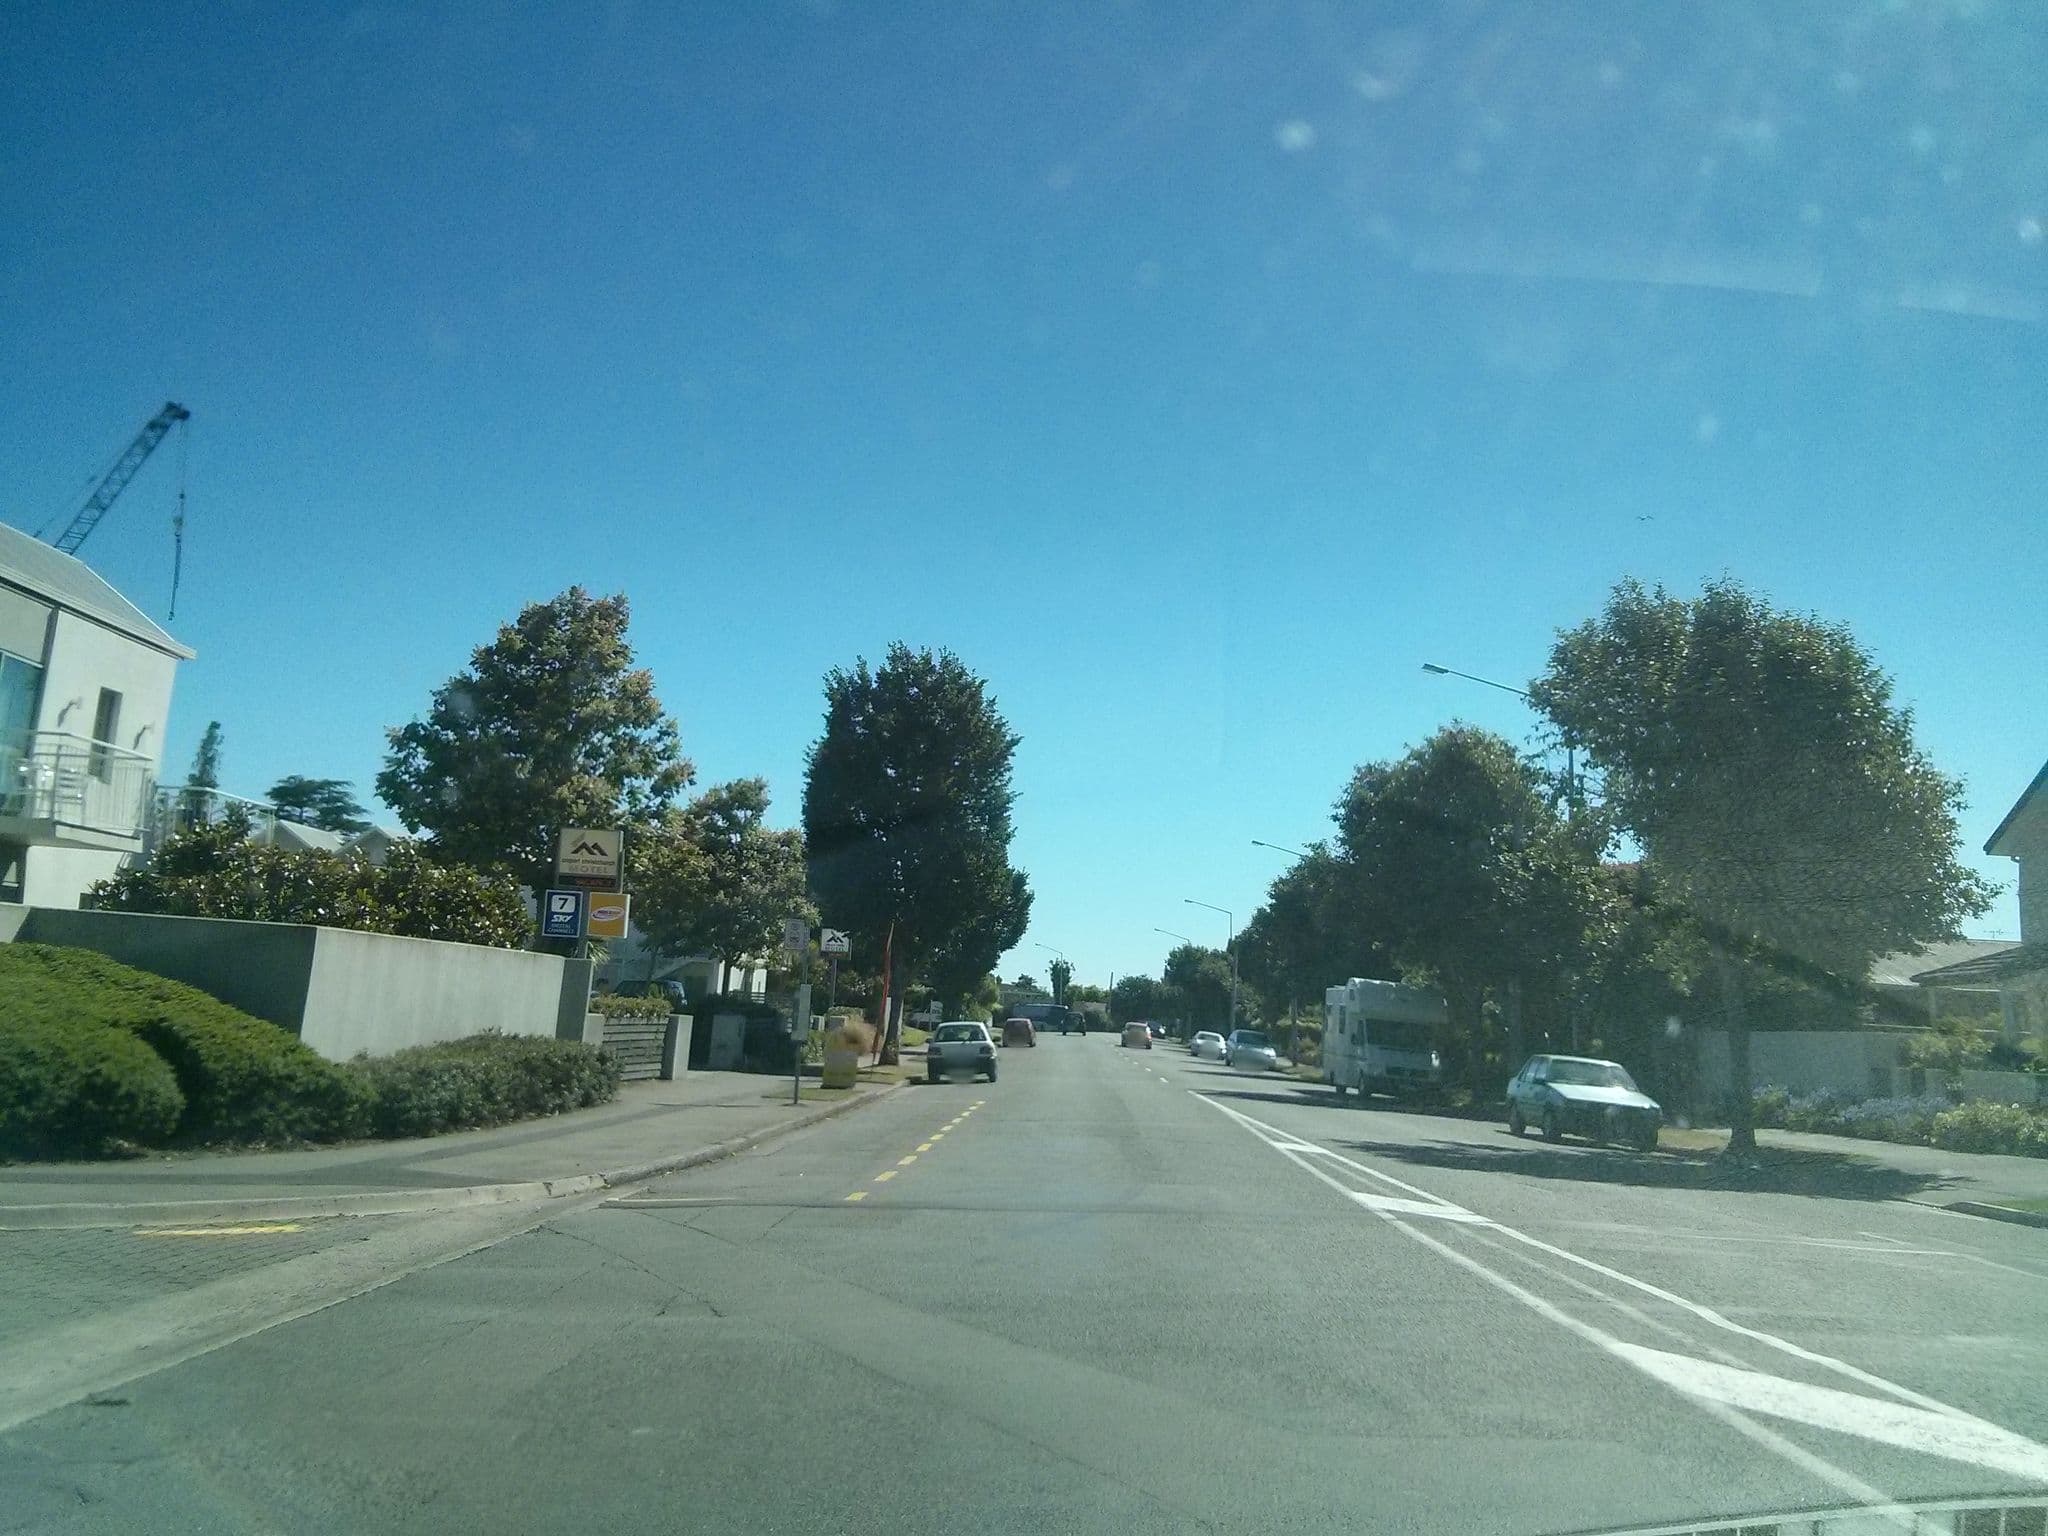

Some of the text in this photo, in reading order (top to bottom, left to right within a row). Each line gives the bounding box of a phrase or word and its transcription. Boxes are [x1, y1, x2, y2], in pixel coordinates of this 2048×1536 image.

[569, 865, 609, 874] MOTEL
[558, 897, 569, 910] 7
[551, 914, 574, 923] SKY
